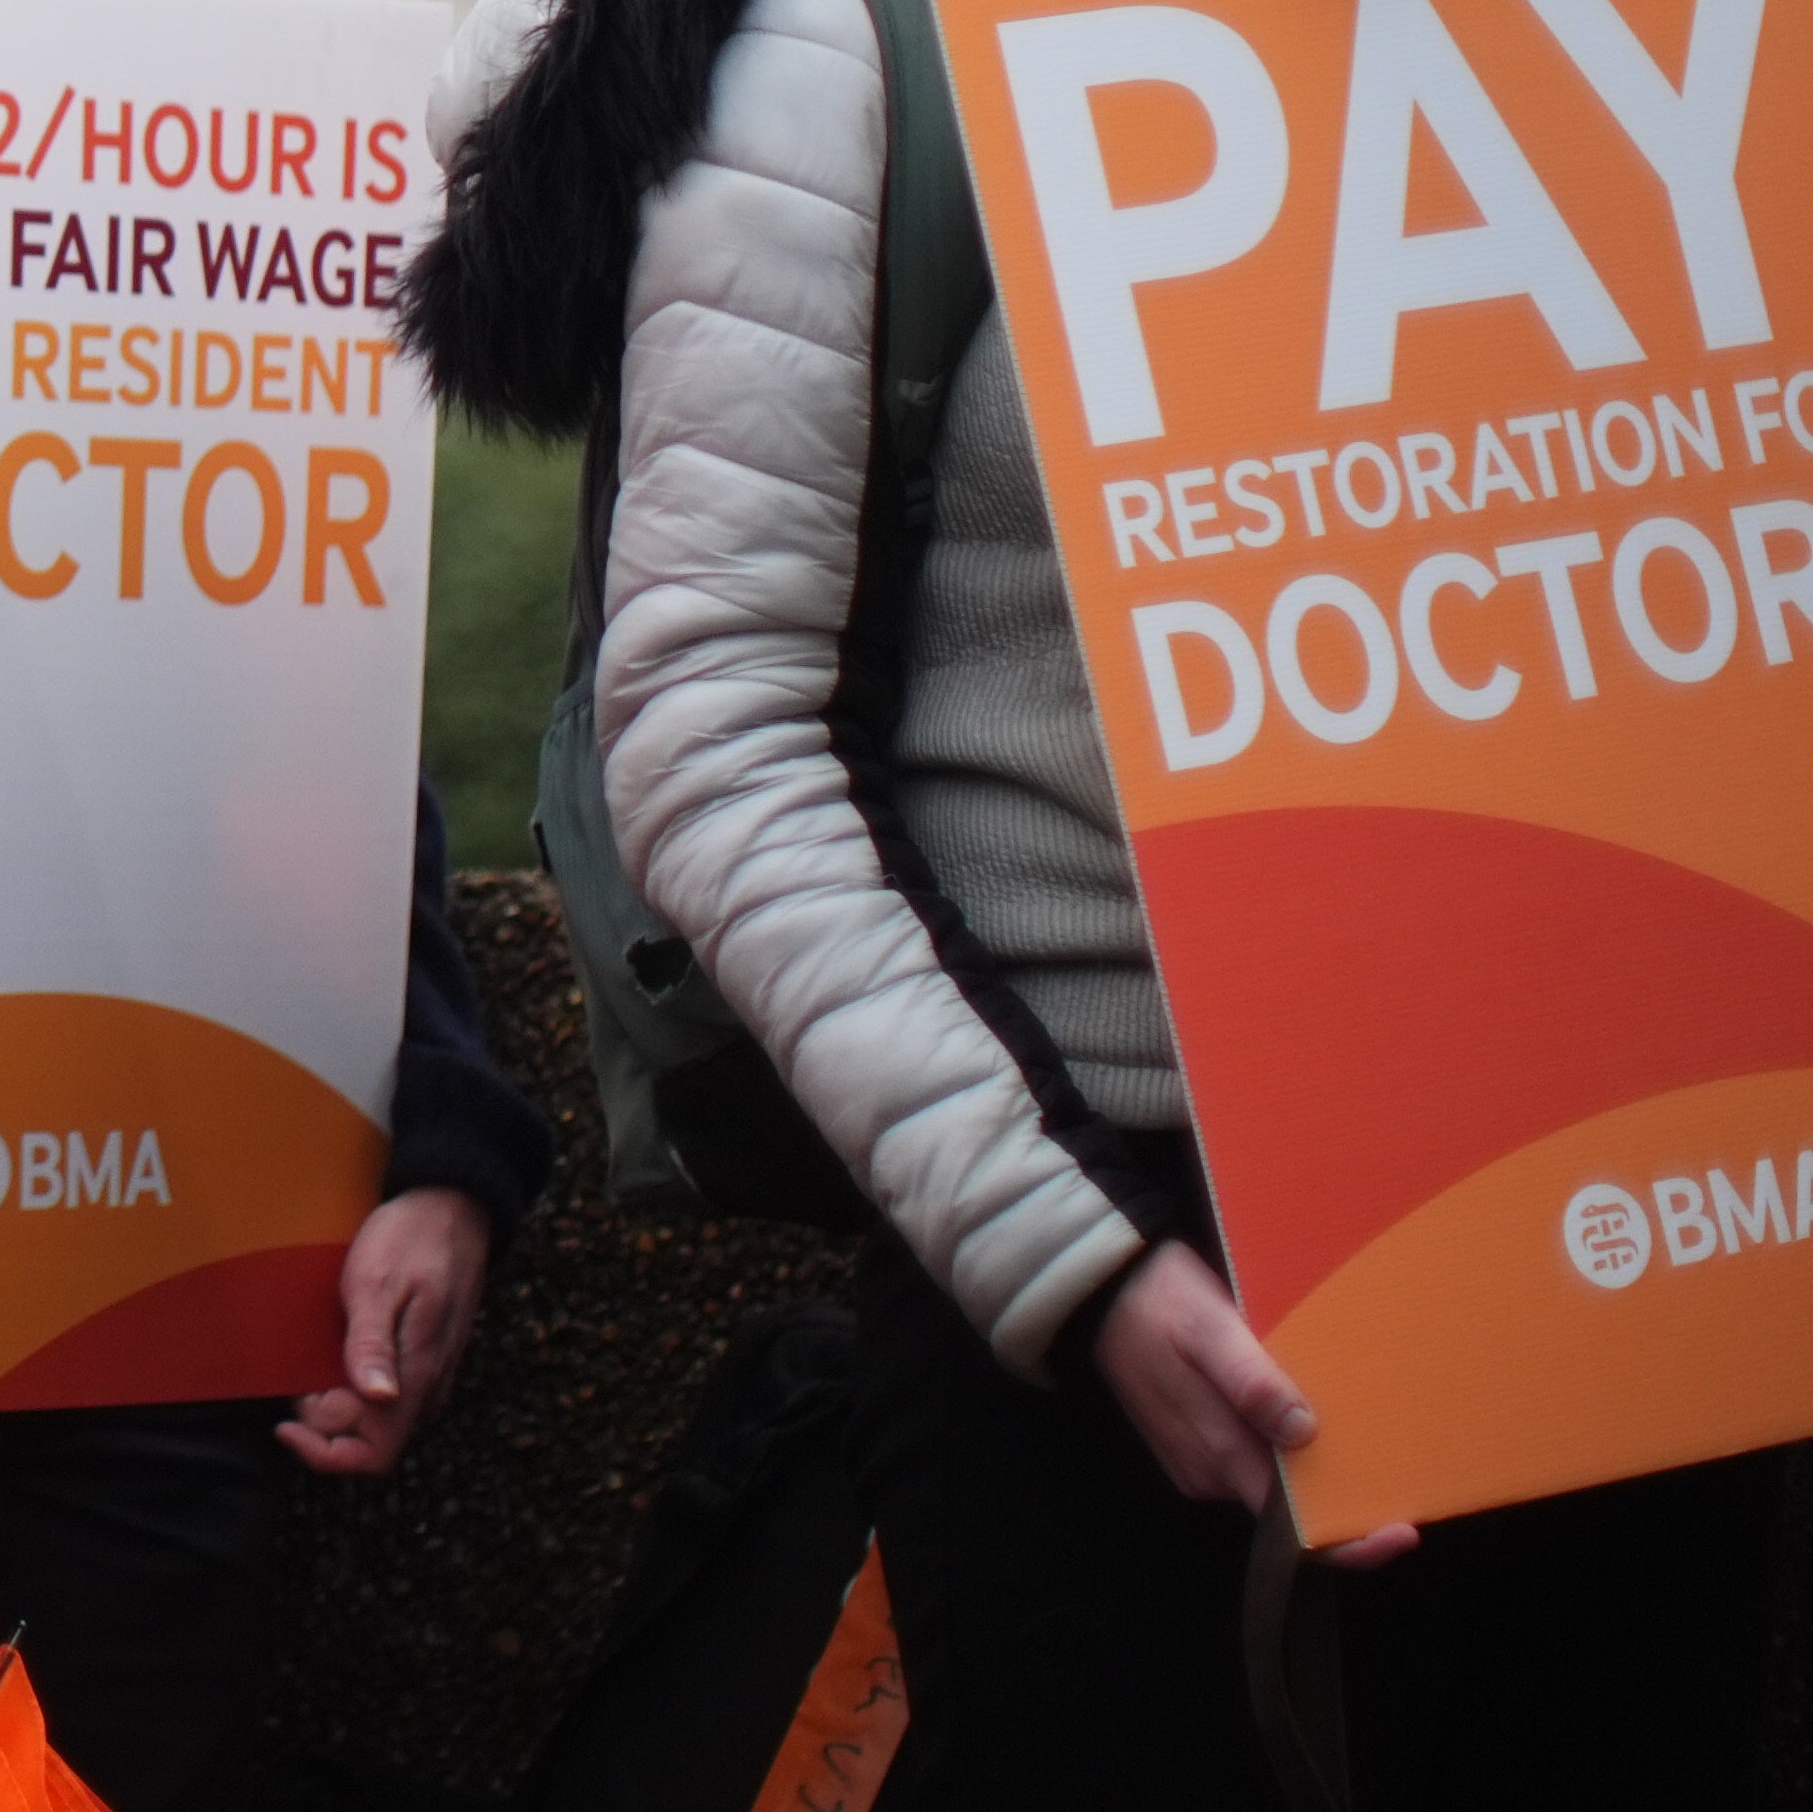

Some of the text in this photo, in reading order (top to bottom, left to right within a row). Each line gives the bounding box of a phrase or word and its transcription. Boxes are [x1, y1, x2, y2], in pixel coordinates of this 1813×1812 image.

[341, 118, 407, 204] IS
[10, 208, 175, 298] FAIR
[197, 220, 404, 311] WAGE
[11, 318, 398, 417] RESIDENT
[1102, 388, 1724, 569] RESTORATION
[20, 1128, 172, 1211] BMA
